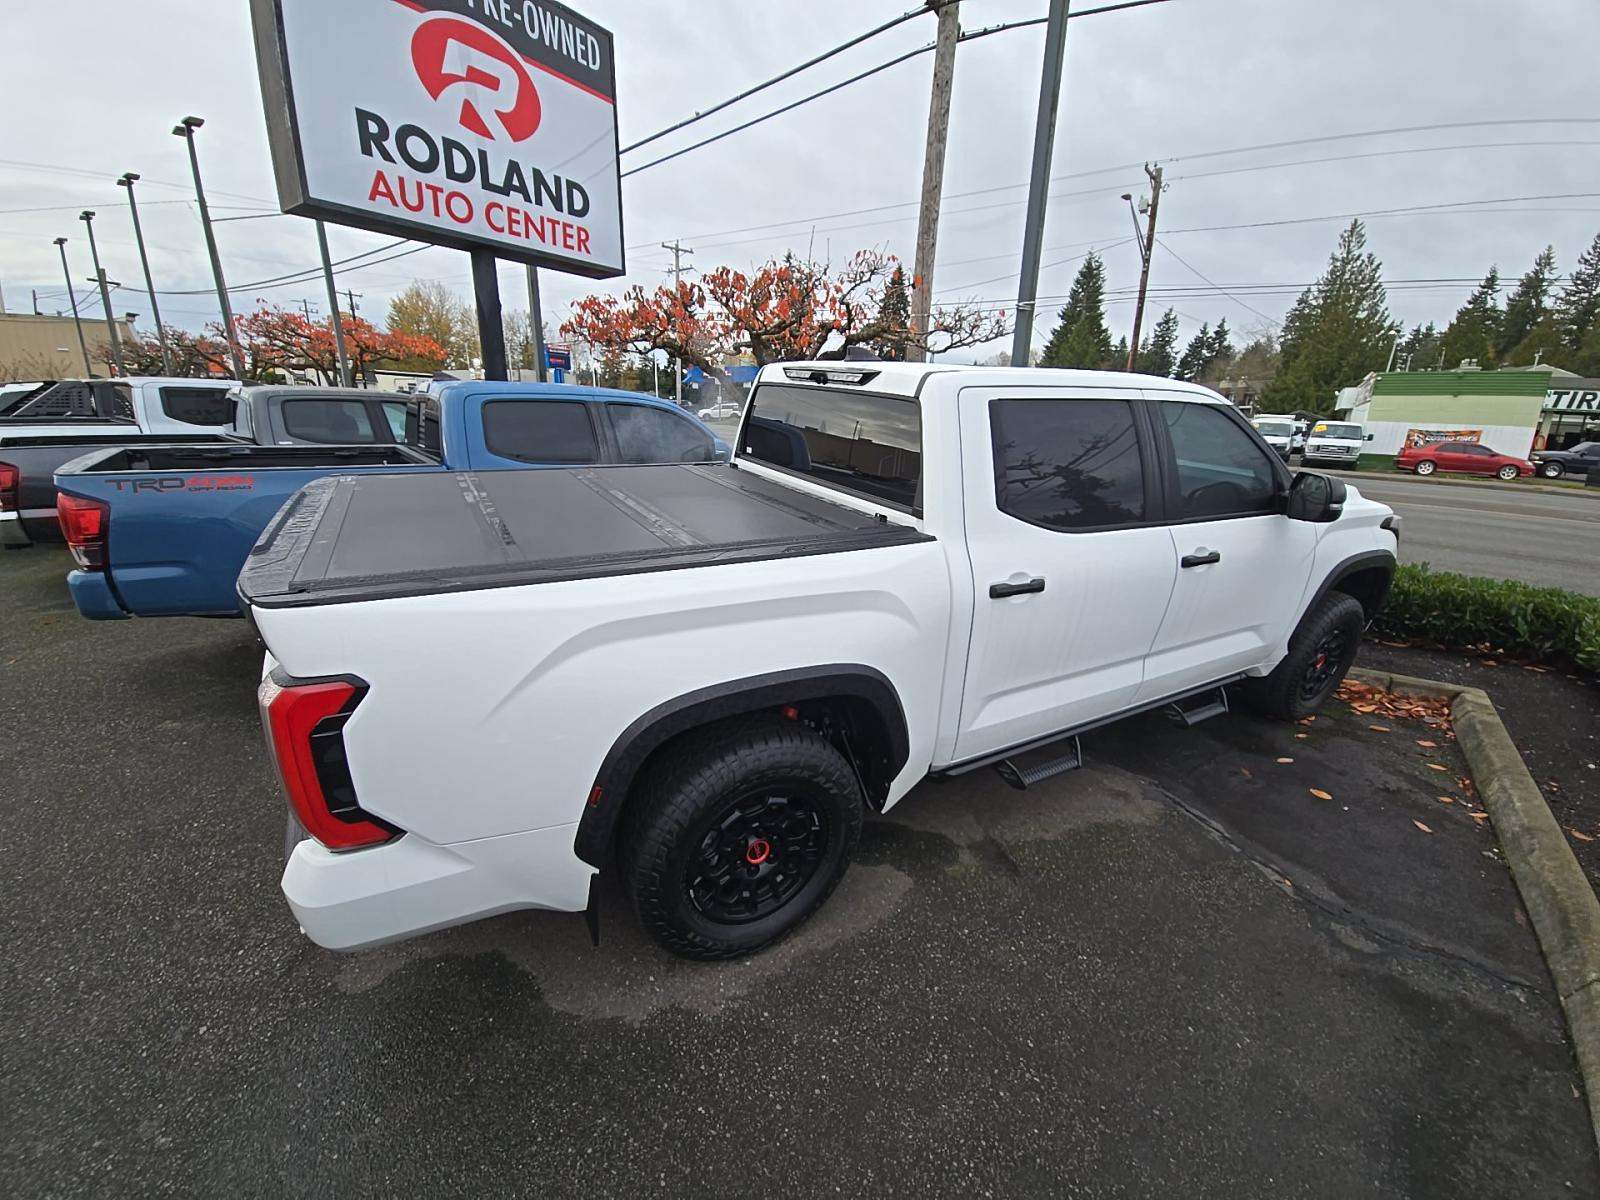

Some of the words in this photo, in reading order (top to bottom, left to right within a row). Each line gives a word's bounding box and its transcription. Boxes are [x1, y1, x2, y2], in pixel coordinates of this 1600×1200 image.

[467, 0, 601, 71] E-OWNED
[355, 106, 590, 218] RODLAND
[368, 169, 474, 223] AUTO
[484, 201, 591, 254] CENTER
[105, 477, 186, 494] TRD
